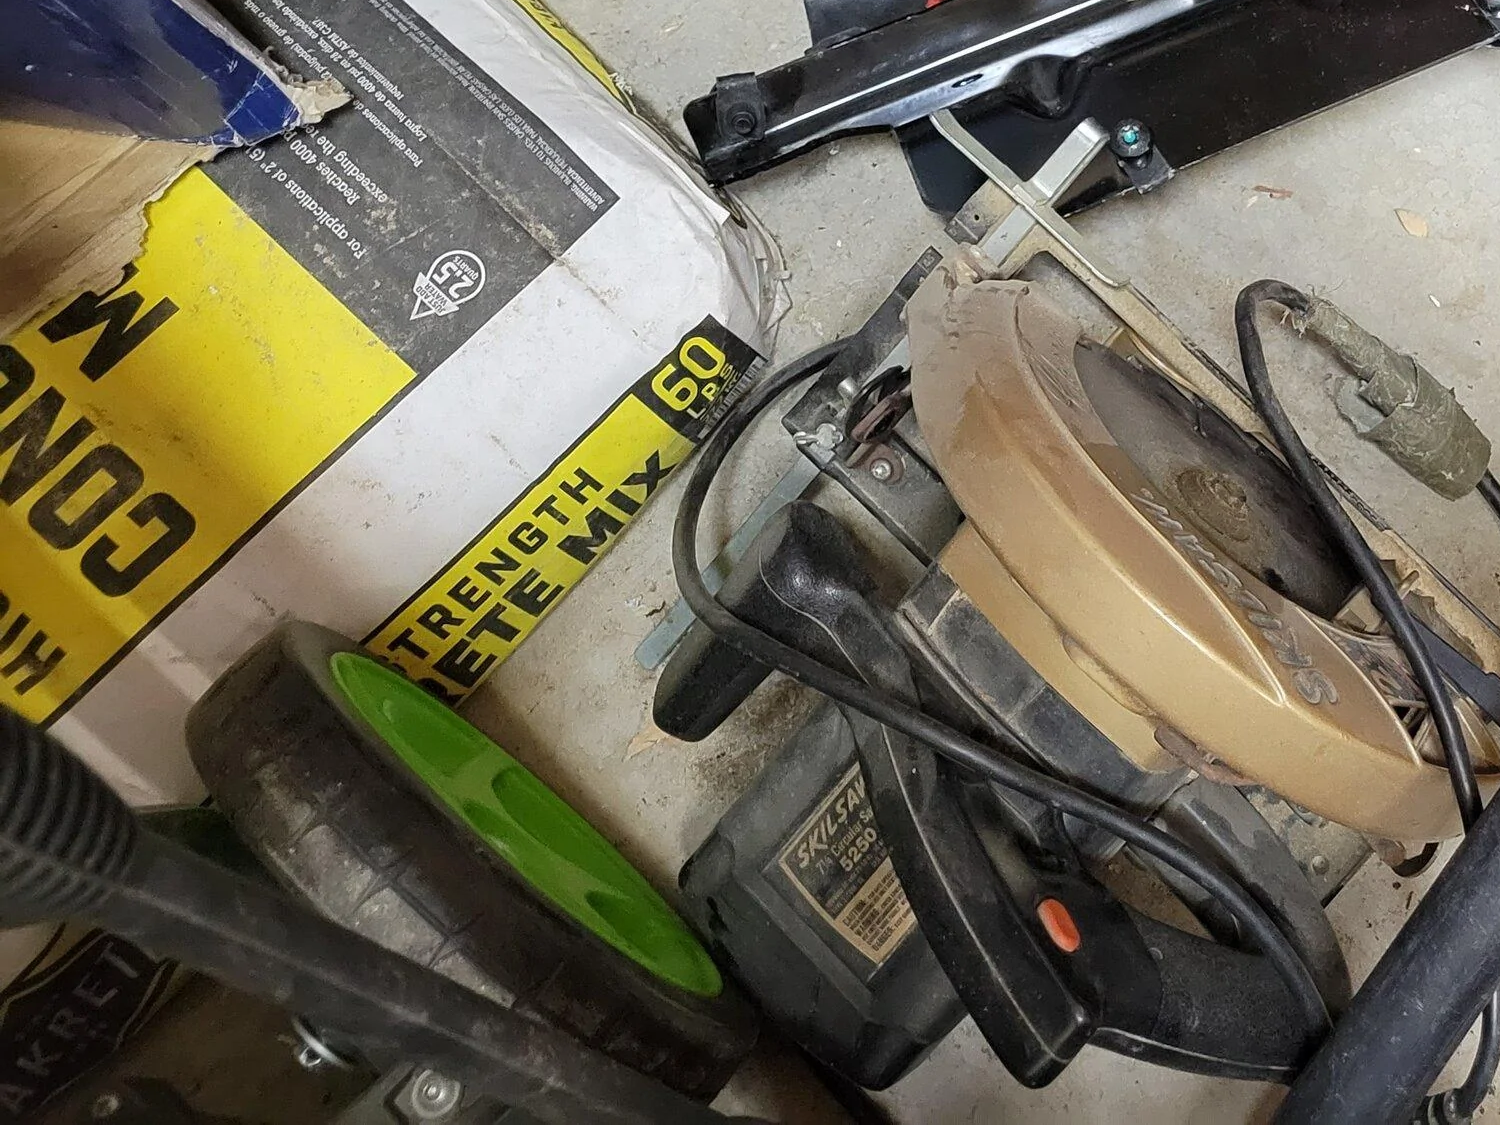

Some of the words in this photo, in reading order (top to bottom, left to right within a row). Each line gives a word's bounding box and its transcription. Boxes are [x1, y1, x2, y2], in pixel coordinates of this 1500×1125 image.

[261, 13, 287, 38] grueso
[281, 33, 294, 46] de
[327, 30, 350, 53] ASTM
[289, 39, 327, 75] pulgadas)
[329, 50, 342, 63] 28
[339, 58, 351, 69] en
[346, 47, 358, 60] de
[346, 63, 363, 80] psi
[355, 53, 406, 101] requerimientos
[356, 74, 377, 94] 4000
[350, 98, 364, 112] de
[372, 89, 386, 103] de
[381, 98, 407, 123] fuerza
[360, 106, 408, 152] aplicaciones
[402, 115, 430, 142] Logra
[288, 137, 319, 167] 4000
[313, 134, 336, 156] the
[259, 156, 276, 174] 2"
[402, 147, 423, 167] Para
[270, 167, 288, 185] of
[313, 160, 361, 206] Reaches
[330, 148, 390, 205] exceeding
[282, 176, 351, 242] applications
[343, 236, 367, 259] For
[452, 254, 479, 280] QUARTS
[431, 258, 474, 300] 2.5
[415, 285, 430, 300] ADD
[424, 282, 448, 305] WATER
[428, 297, 445, 314] JUST
[648, 336, 725, 411] 60
[556, 449, 679, 565] MIX
[0, 591, 67, 696] HI
[858, 804, 874, 822] Sa
[838, 826, 879, 872] 5250
[0, 940, 142, 1116] AKRET
